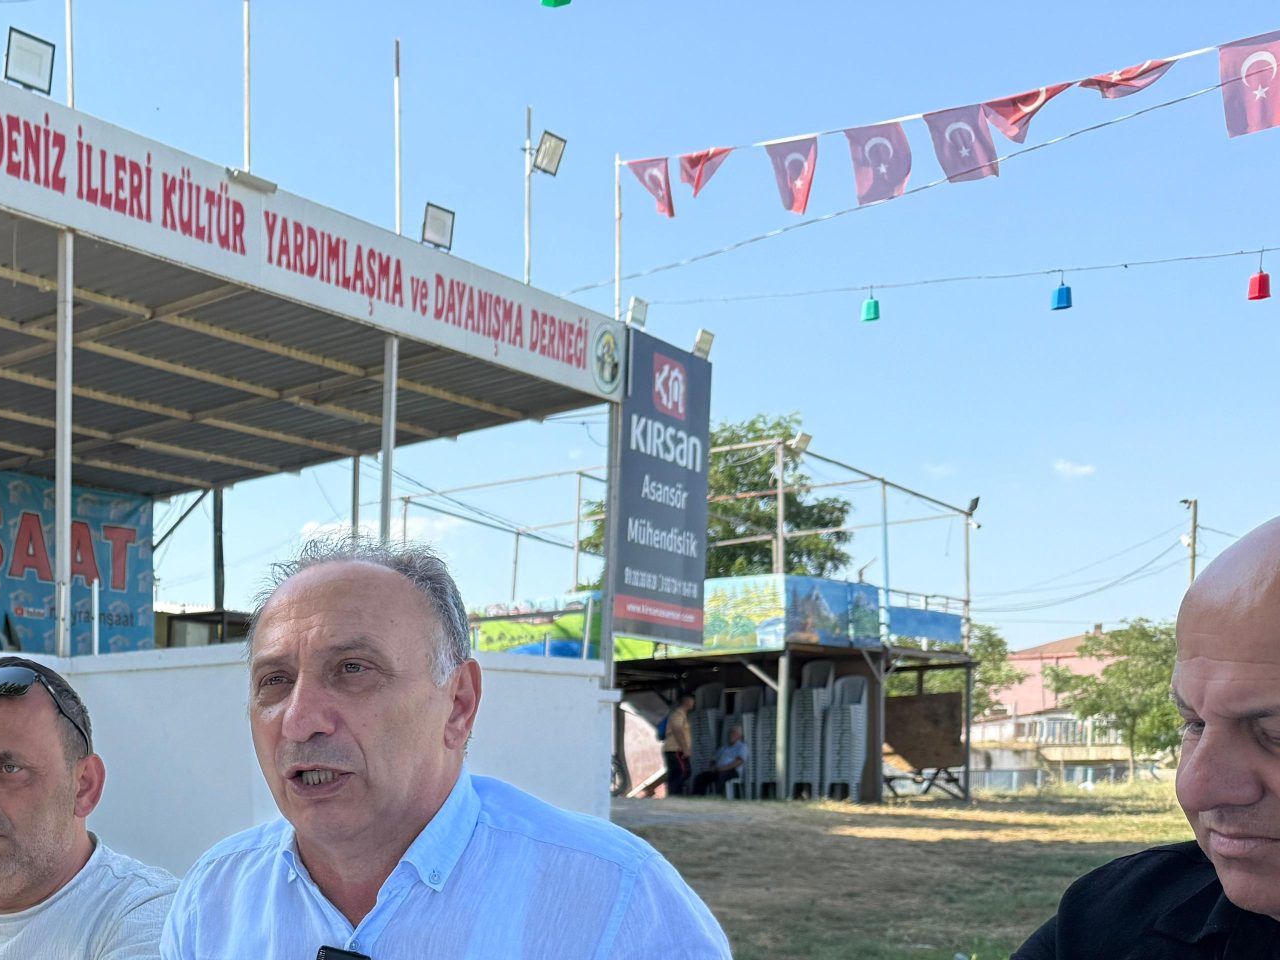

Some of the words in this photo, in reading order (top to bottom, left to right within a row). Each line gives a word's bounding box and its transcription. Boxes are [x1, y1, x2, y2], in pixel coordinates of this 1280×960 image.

[76, 124, 154, 224] İLLERİ
[161, 166, 247, 256] KÜLTÜR
[263, 209, 405, 317] YARDIMLAŞMA
[410, 275, 428, 314] ve
[434, 272, 525, 356] DAYANIŞMA
[529, 308, 589, 371] DERNEĞİ
[641, 474, 689, 510] Asansör
[627, 517, 698, 558] Mühendislik
